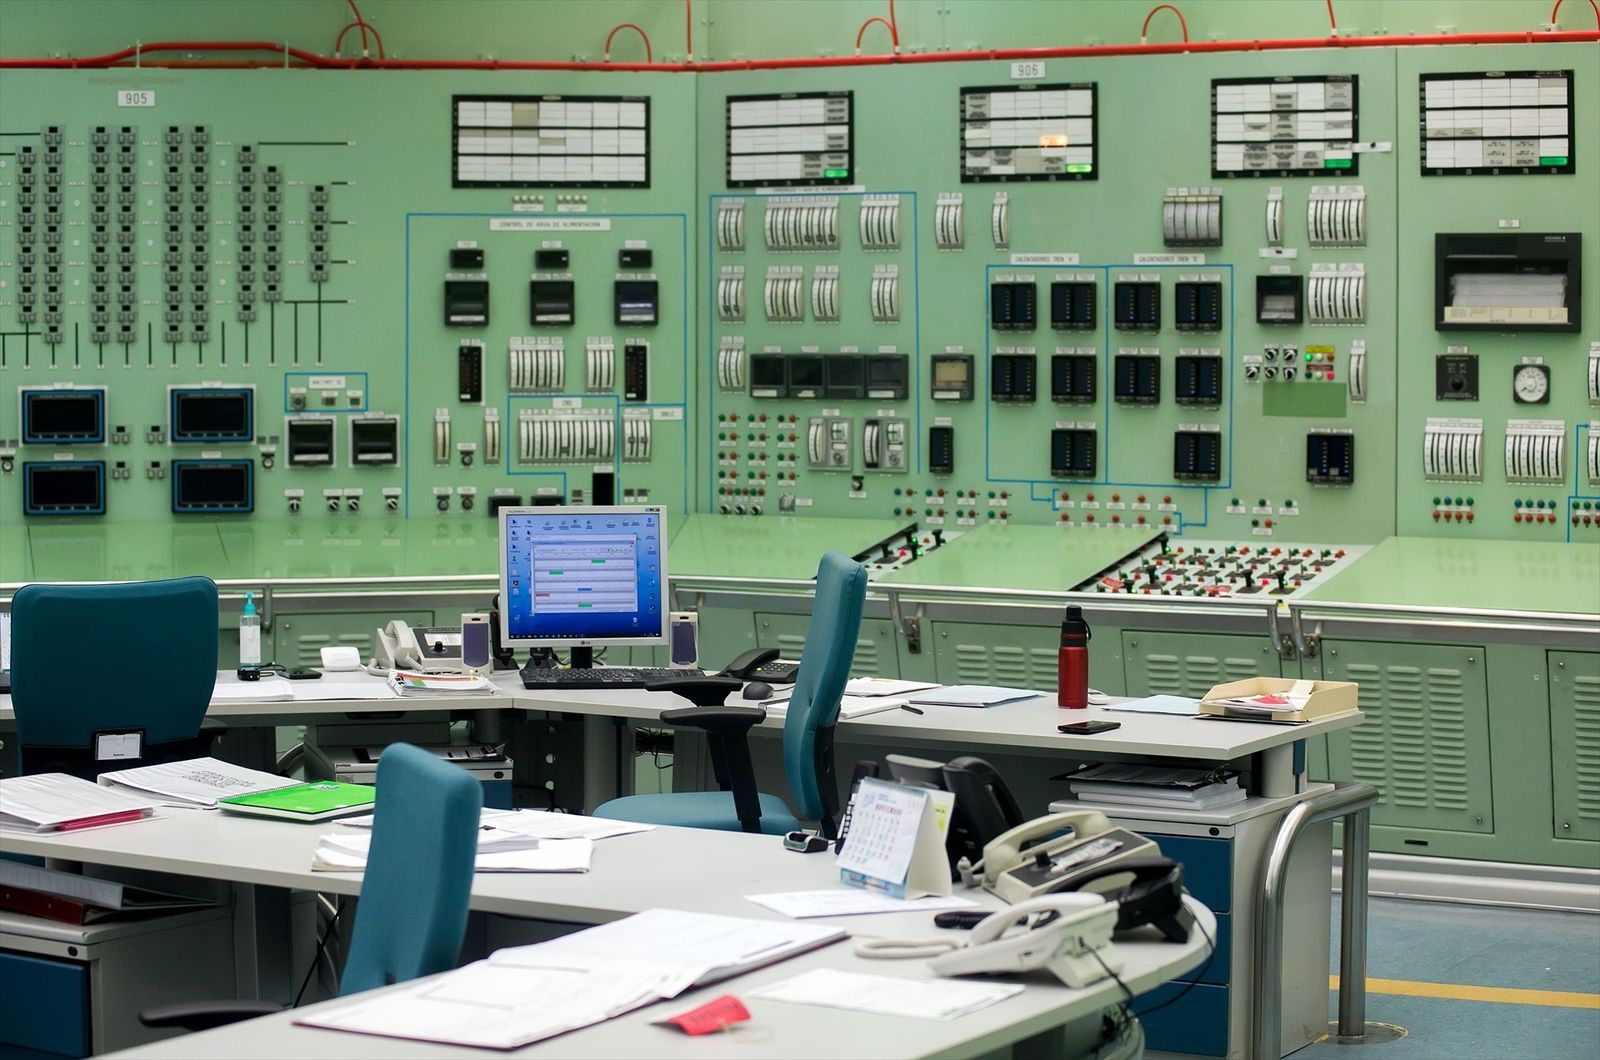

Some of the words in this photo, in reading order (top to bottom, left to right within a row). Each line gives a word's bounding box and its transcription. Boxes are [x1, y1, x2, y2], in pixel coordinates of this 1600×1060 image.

[1018, 64, 1039, 77] 906
[125, 92, 148, 105] 905
[1177, 255, 1189, 263] TREN
